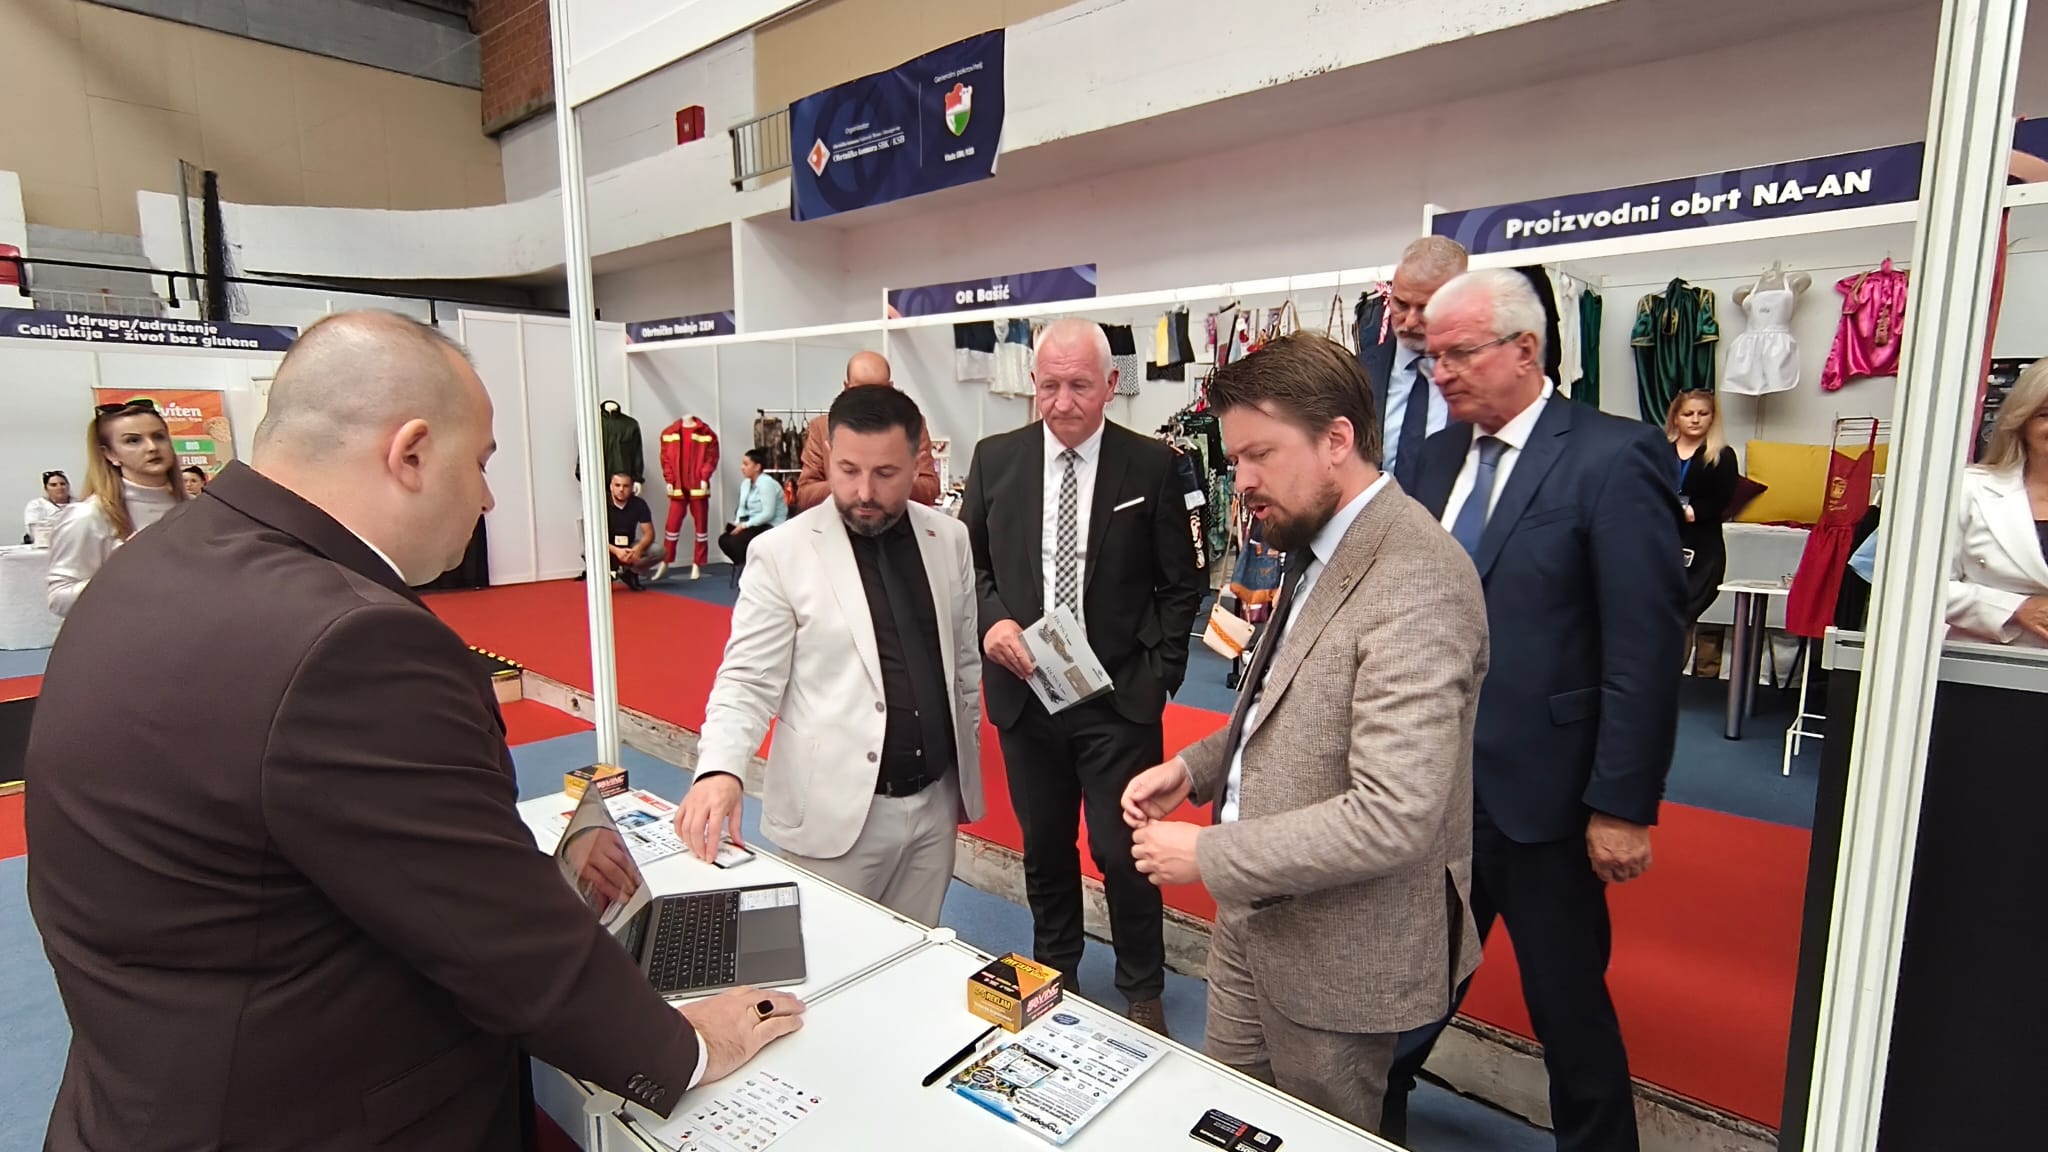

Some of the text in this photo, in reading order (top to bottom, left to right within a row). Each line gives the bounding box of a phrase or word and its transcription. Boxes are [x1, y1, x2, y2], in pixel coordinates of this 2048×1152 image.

[1505, 169, 1872, 239] Proizvodni obrt NA-AN
[955, 284, 1010, 304] OR Bašić
[18, 324, 103, 341] Celijakija
[124, 331, 165, 343] život
[170, 333, 197, 345] bez
[202, 335, 258, 348] glutena
[65, 314, 218, 336] Udruga/udruženje
[155, 402, 202, 417] viten
